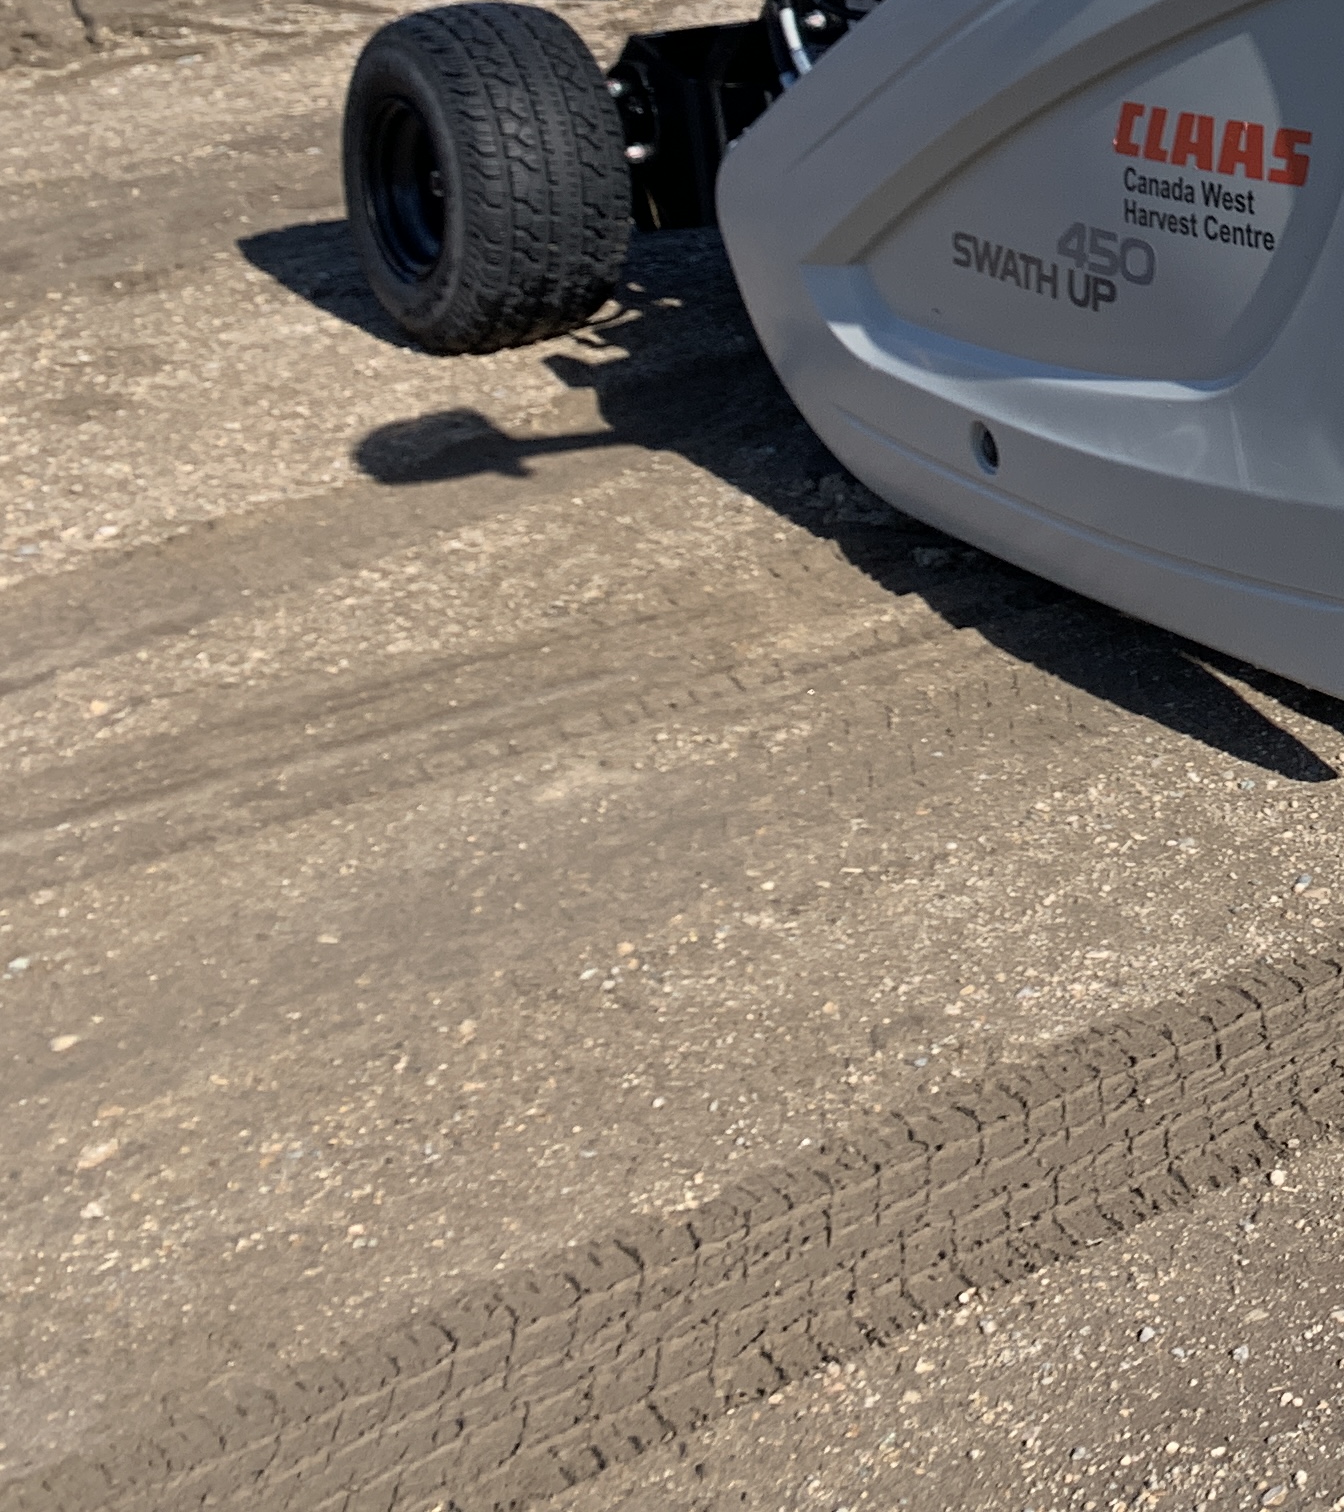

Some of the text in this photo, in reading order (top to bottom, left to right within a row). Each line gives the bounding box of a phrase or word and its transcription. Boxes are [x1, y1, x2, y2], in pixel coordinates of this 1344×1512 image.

[1112, 101, 1314, 188] CLAAS
[1123, 165, 1255, 215] Canada West
[1057, 221, 1157, 286] 450
[1123, 198, 1276, 251] Harvest Centre
[952, 231, 1117, 312] SWATH UP
